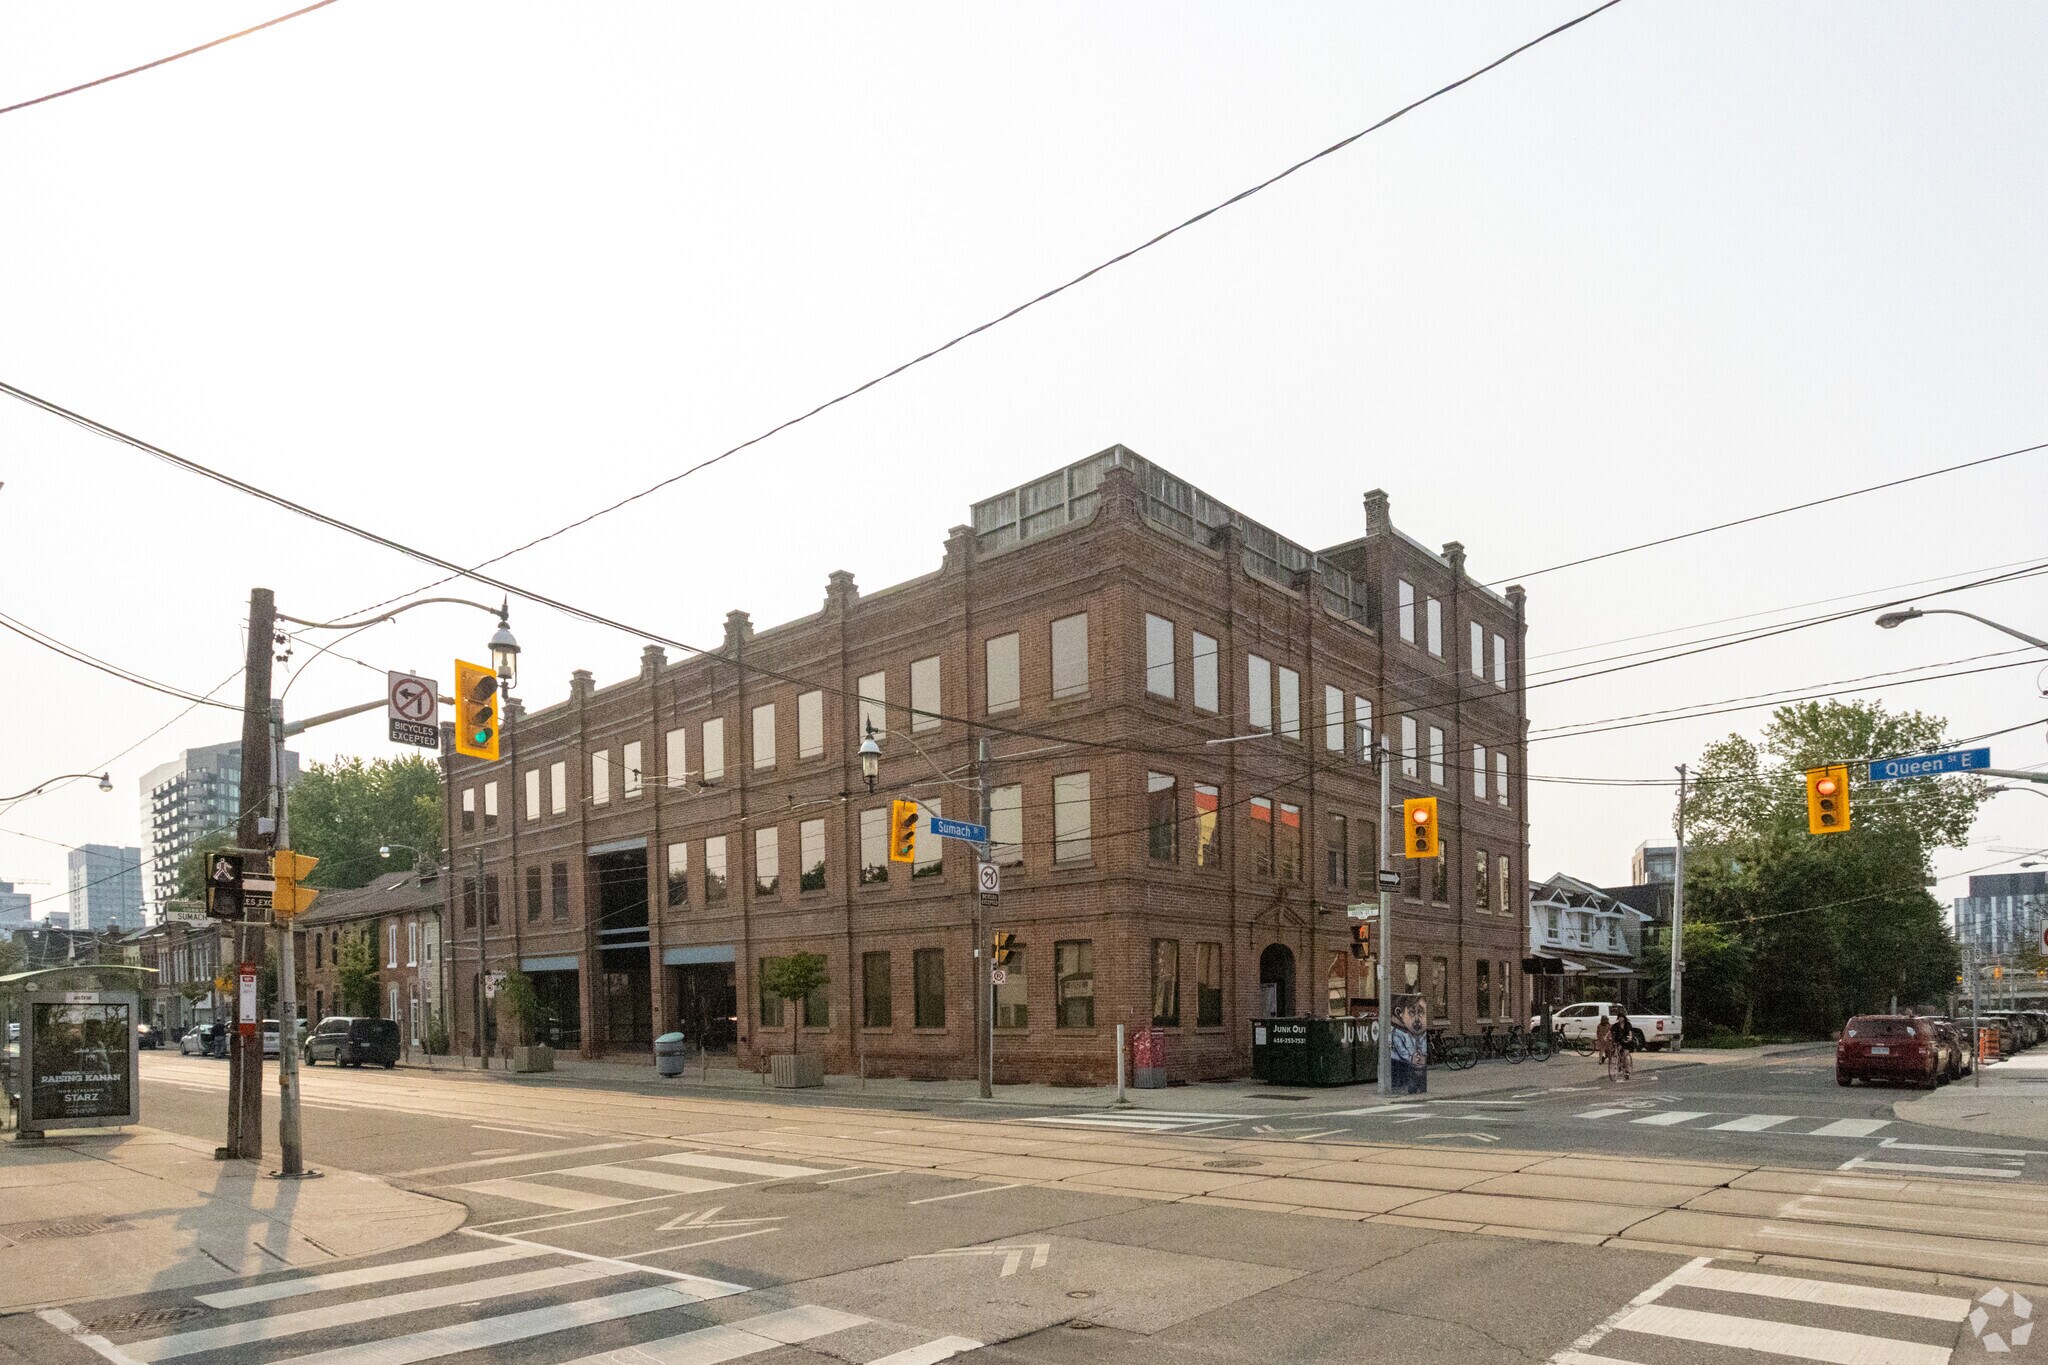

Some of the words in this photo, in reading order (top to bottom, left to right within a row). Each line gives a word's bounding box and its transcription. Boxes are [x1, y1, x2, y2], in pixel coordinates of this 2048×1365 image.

[394, 721, 434, 736] BICYCLES
[392, 731, 436, 746] EXCEPTED
[1885, 760, 1943, 777] Queen
[1947, 754, 1957, 763] St
[1961, 753, 1972, 767] E
[938, 821, 971, 837] Sumach
[178, 912, 208, 921] SUMACH
[1341, 1022, 1369, 1043] JUNK
[41, 1075, 82, 1083] RAISING
[85, 1073, 121, 1081] KANAN
[64, 1093, 99, 1101] STARZ
